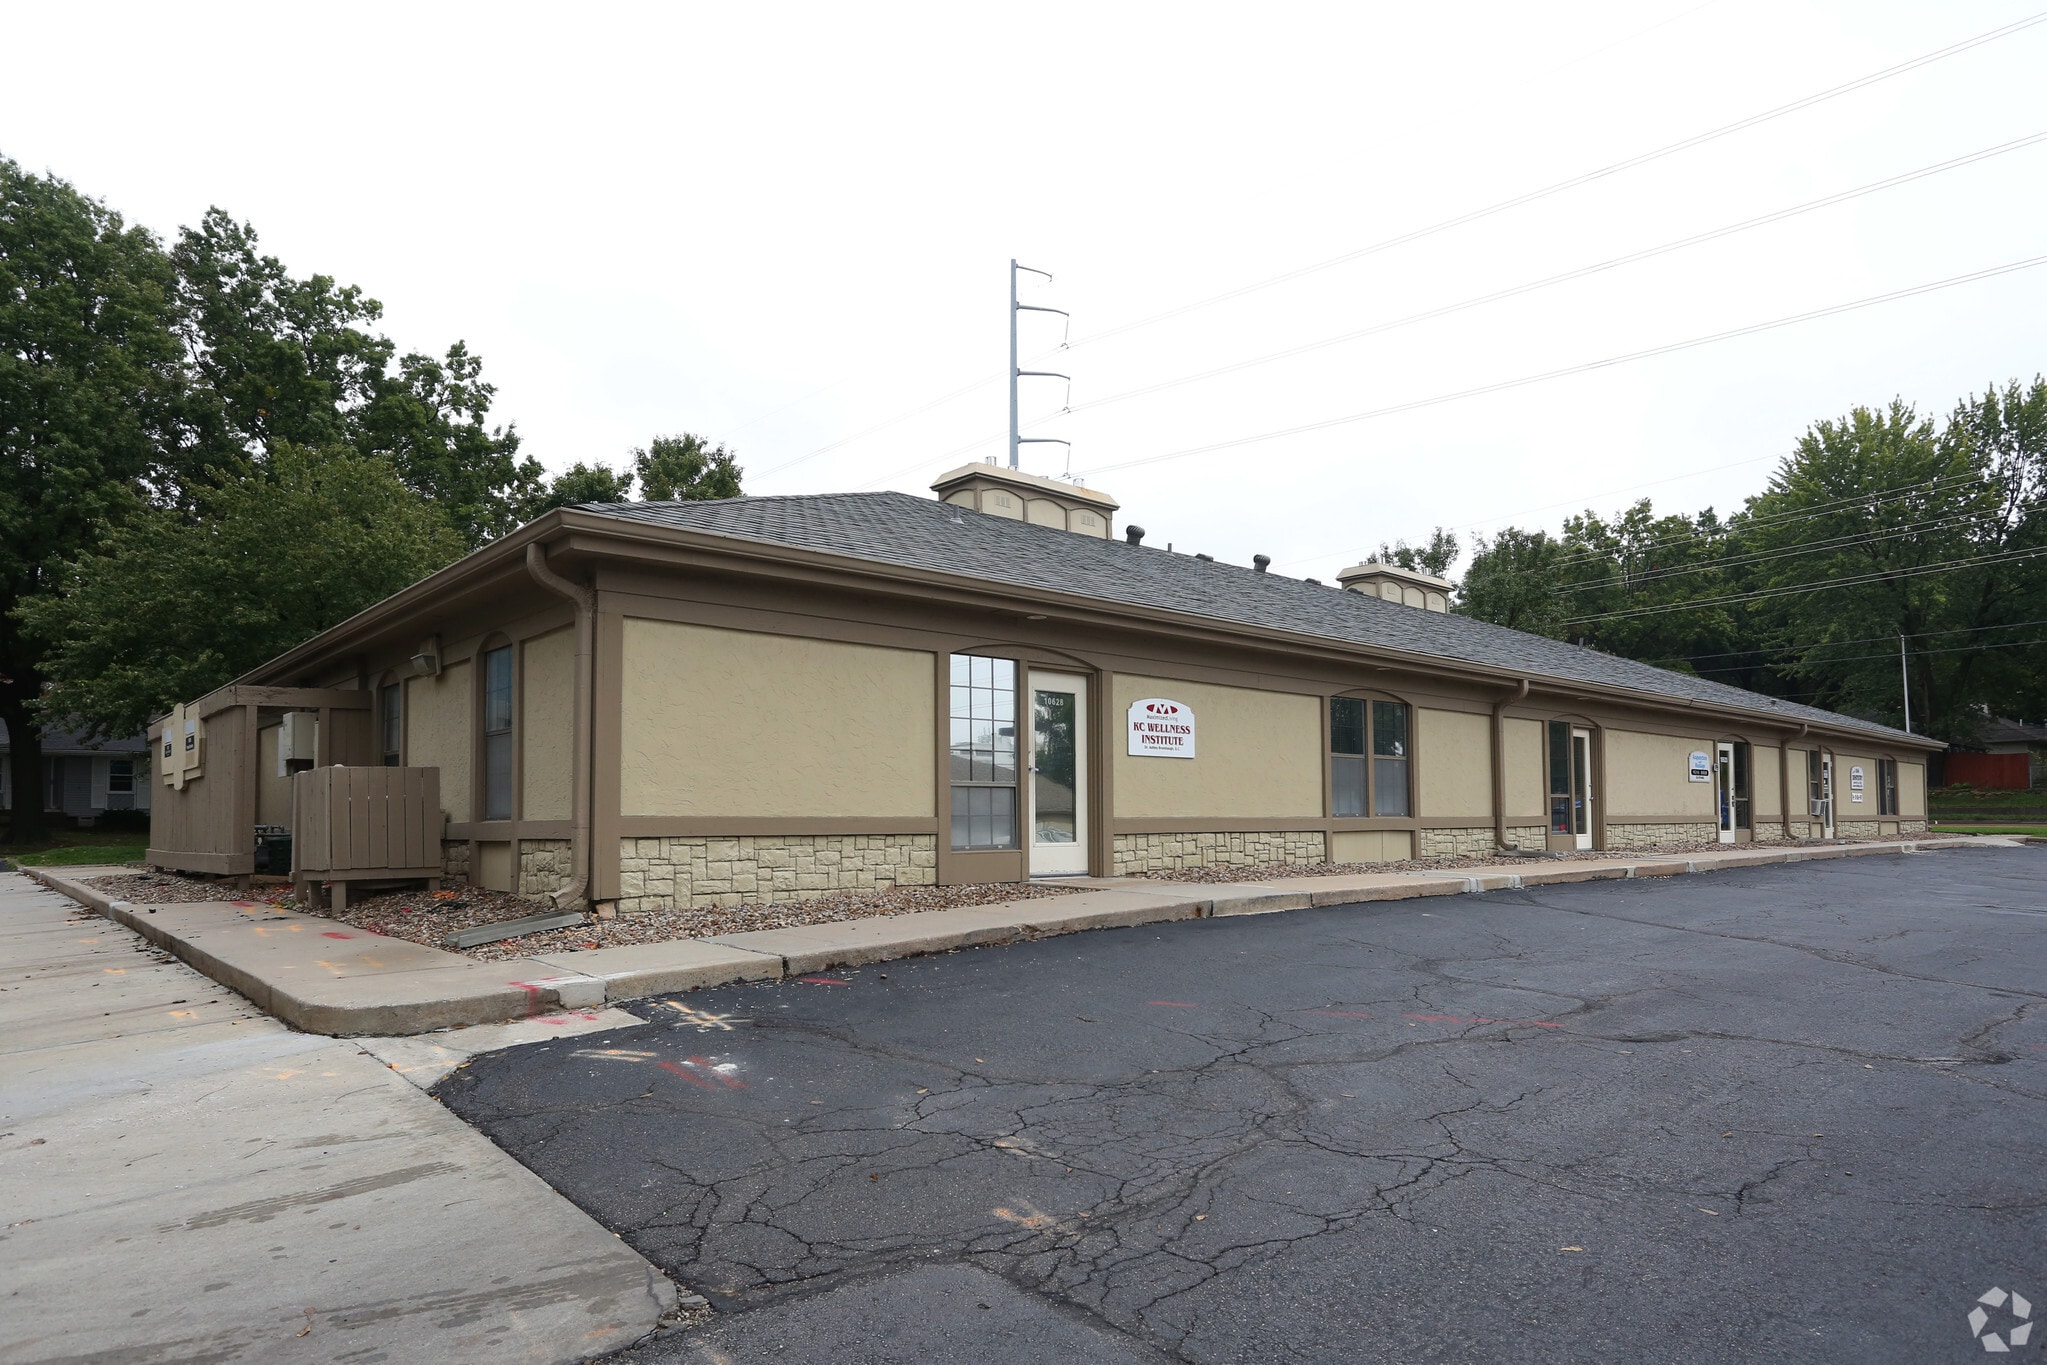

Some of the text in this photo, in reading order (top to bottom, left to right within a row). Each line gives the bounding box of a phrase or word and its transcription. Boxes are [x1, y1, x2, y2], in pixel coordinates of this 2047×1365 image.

[1044, 697, 1064, 706] 10628
[1133, 721, 1191, 734] KC WELLNESS
[1141, 734, 1184, 746] INSTITUTE
